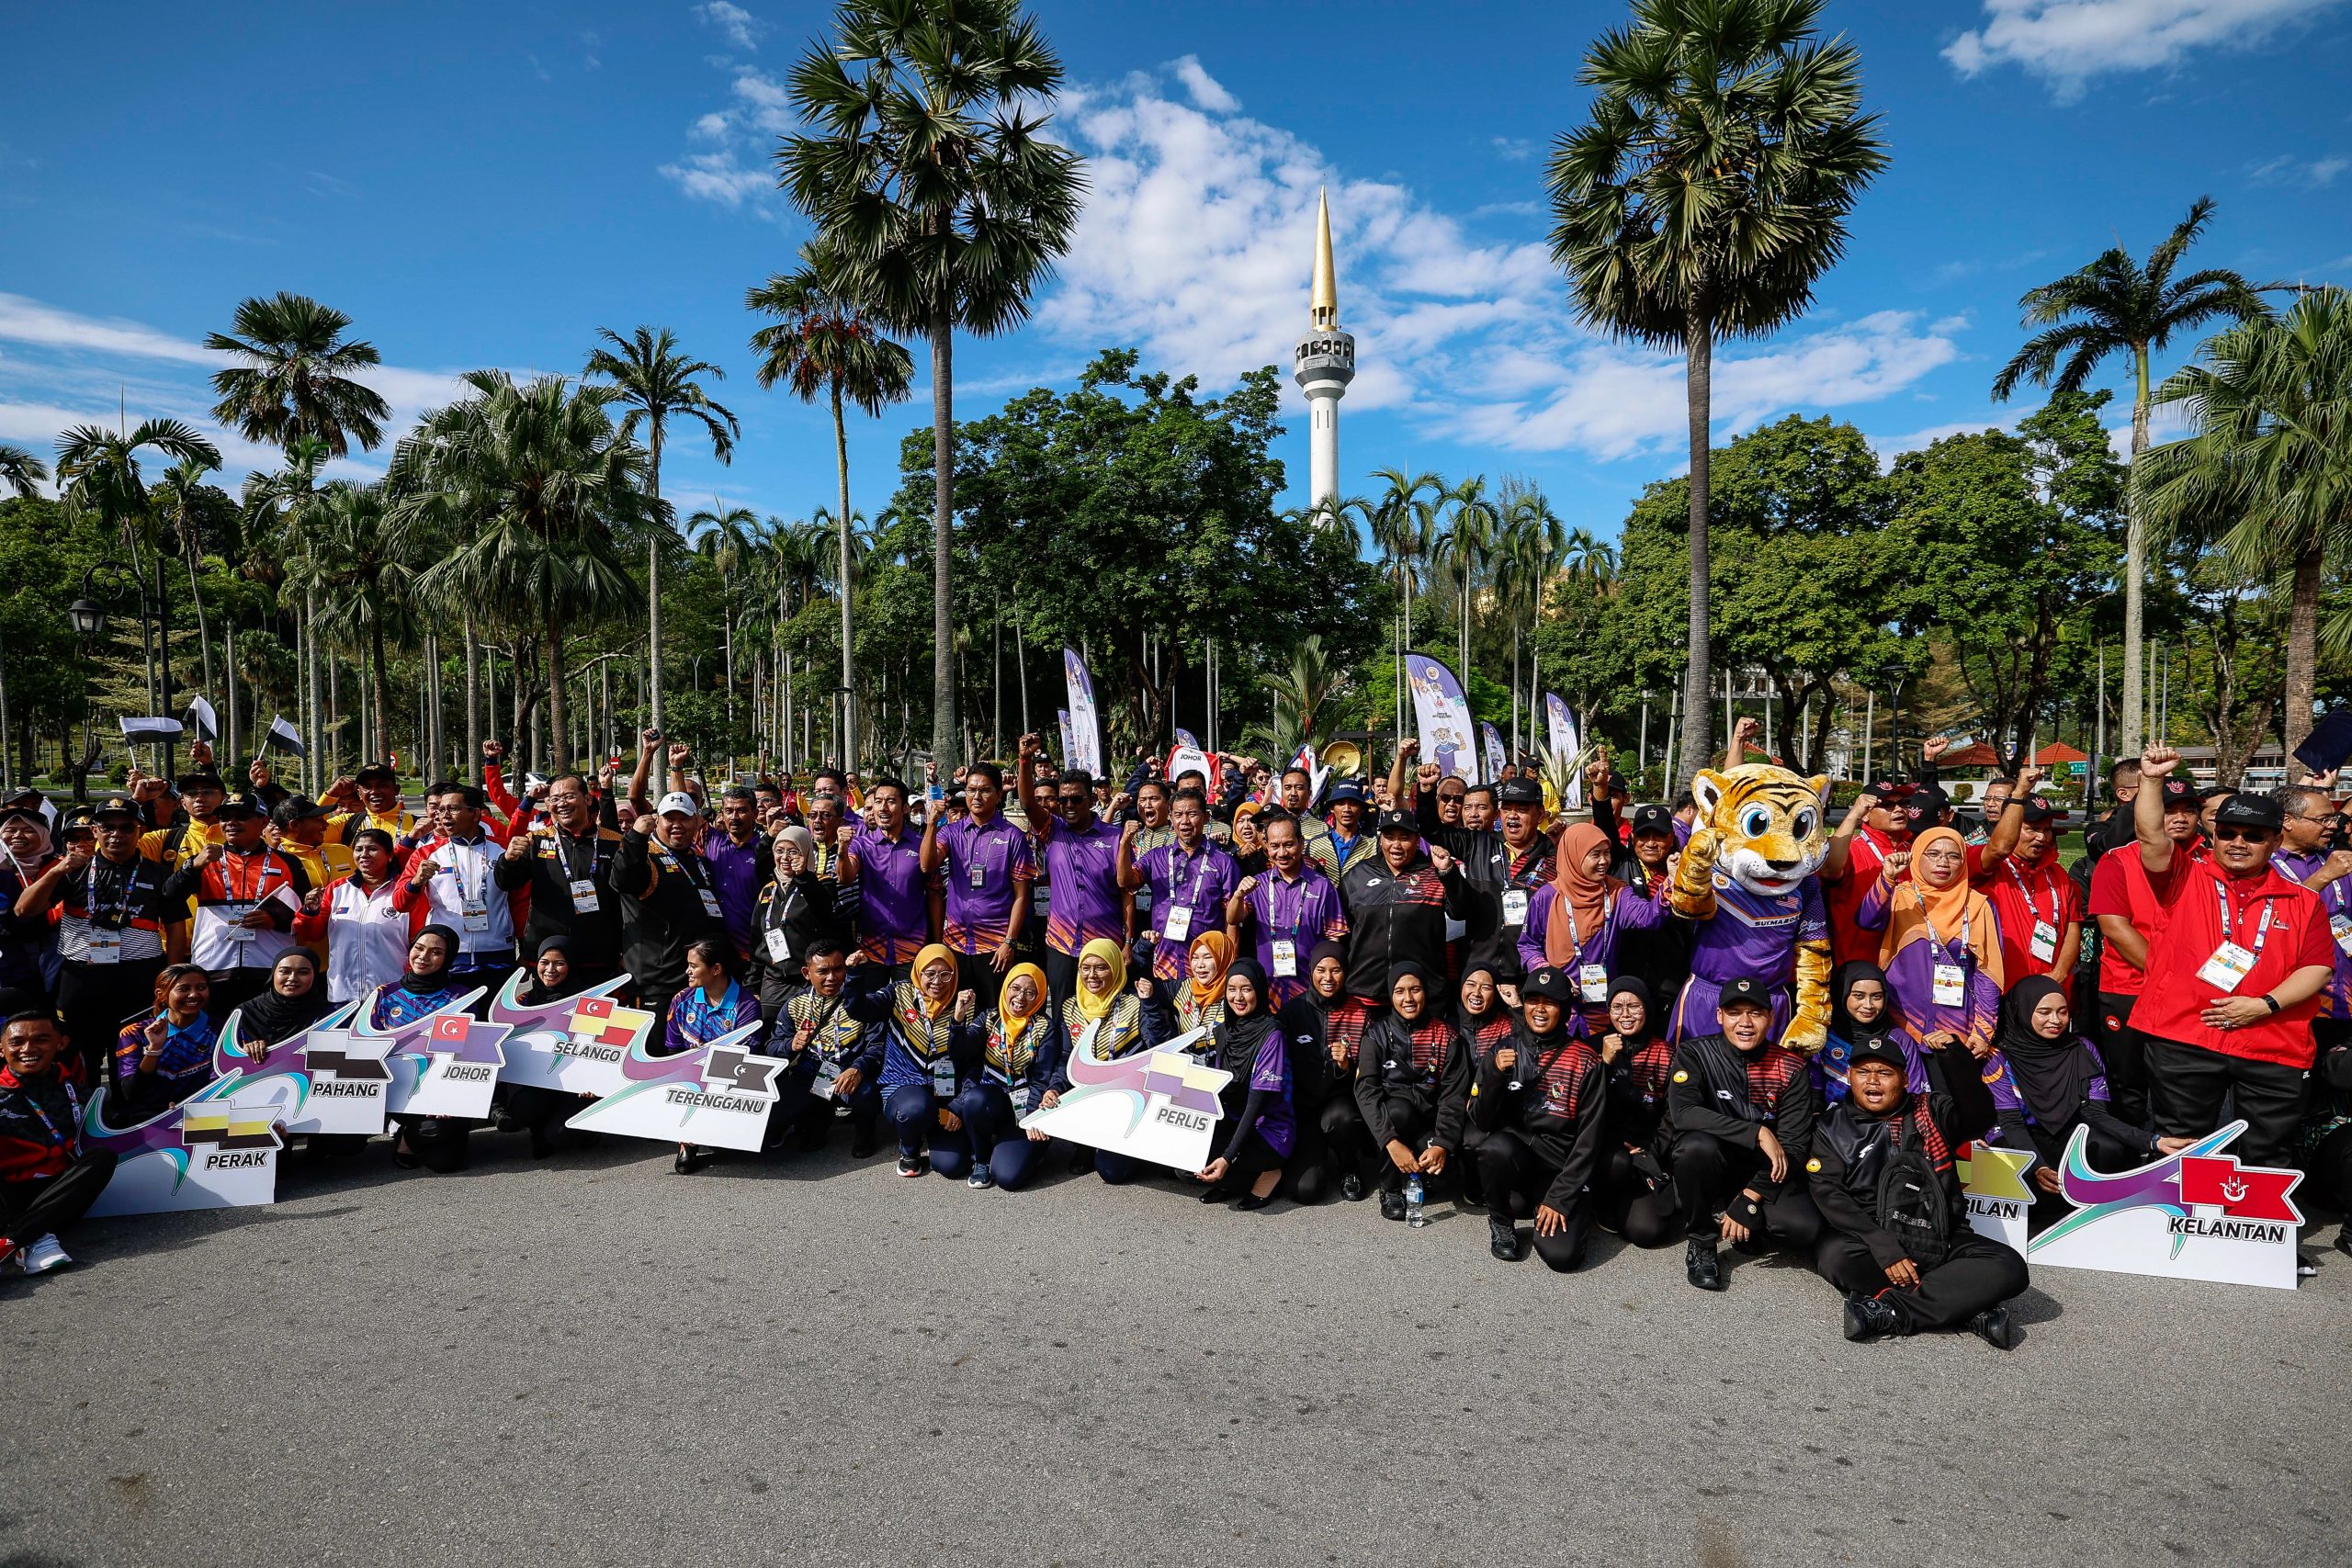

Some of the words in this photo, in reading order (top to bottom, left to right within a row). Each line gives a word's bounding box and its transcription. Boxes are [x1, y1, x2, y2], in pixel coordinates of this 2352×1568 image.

[1180, 753, 1202, 761] JOHOR
[553, 1042, 621, 1062] SELANGO
[442, 1065, 490, 1081] JOHOR
[312, 1081, 379, 1098] PAHANG
[666, 1089, 765, 1113] TERENGGANU
[1157, 1108, 1209, 1132] PERLIS
[205, 1150, 267, 1169] PERAK
[1966, 1197, 2020, 1219] ILAN
[2169, 1217, 2286, 1243] KELANTAN
